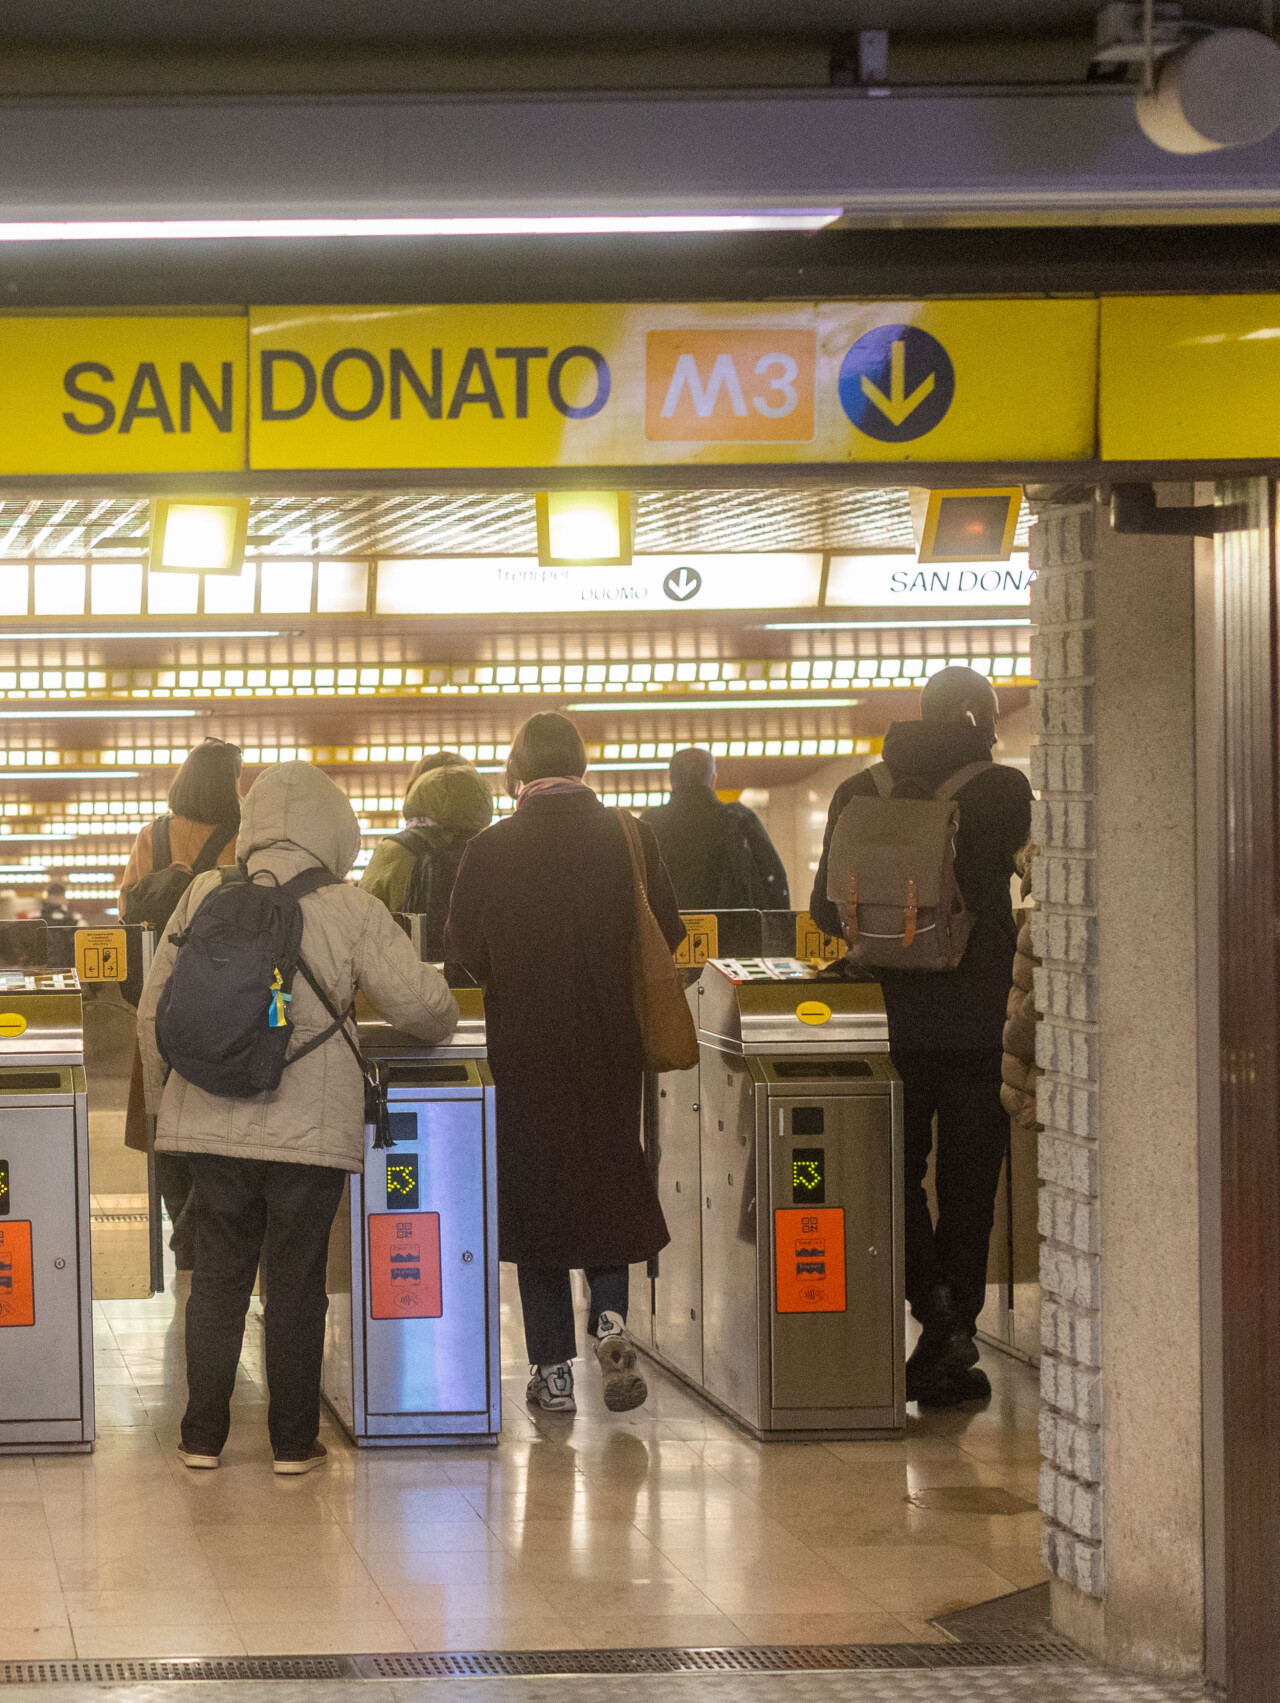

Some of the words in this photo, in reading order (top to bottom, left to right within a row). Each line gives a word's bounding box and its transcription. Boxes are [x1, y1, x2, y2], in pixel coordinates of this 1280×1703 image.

[62, 361, 234, 435] SAN
[261, 344, 612, 422] DONATO
[660, 352, 799, 418] M3
[581, 586, 649, 601] DUOMO
[890, 571, 950, 593] SAN
